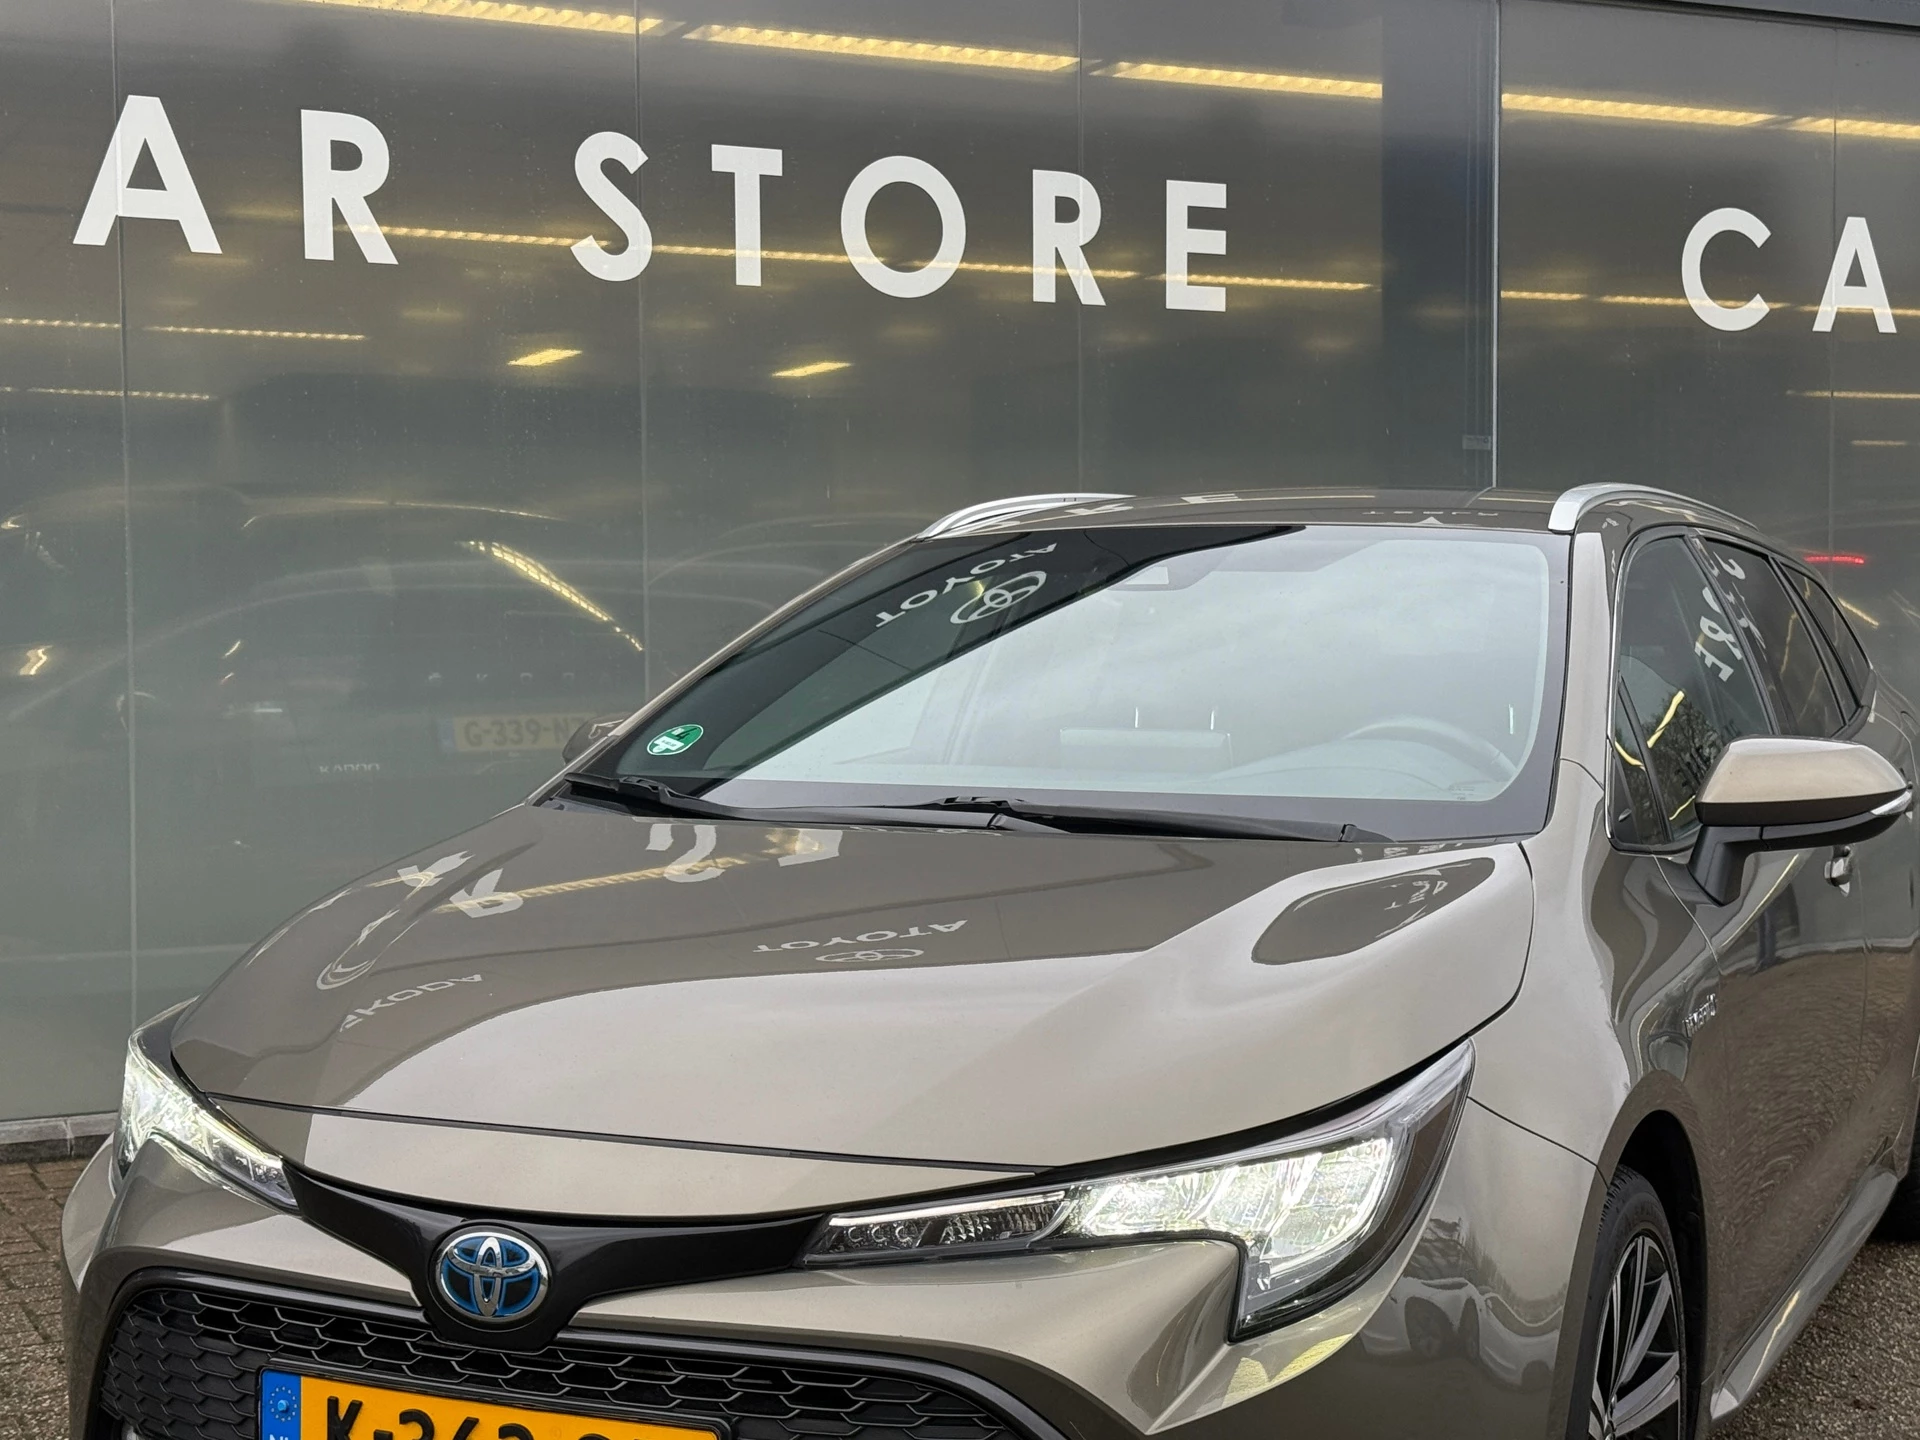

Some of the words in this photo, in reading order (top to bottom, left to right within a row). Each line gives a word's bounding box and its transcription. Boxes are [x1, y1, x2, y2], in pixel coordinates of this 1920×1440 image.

[73, 94, 400, 266] AR
[570, 130, 1228, 313] STORE
[1681, 206, 1898, 334] CA
[463, 717, 585, 749] G-339-N
